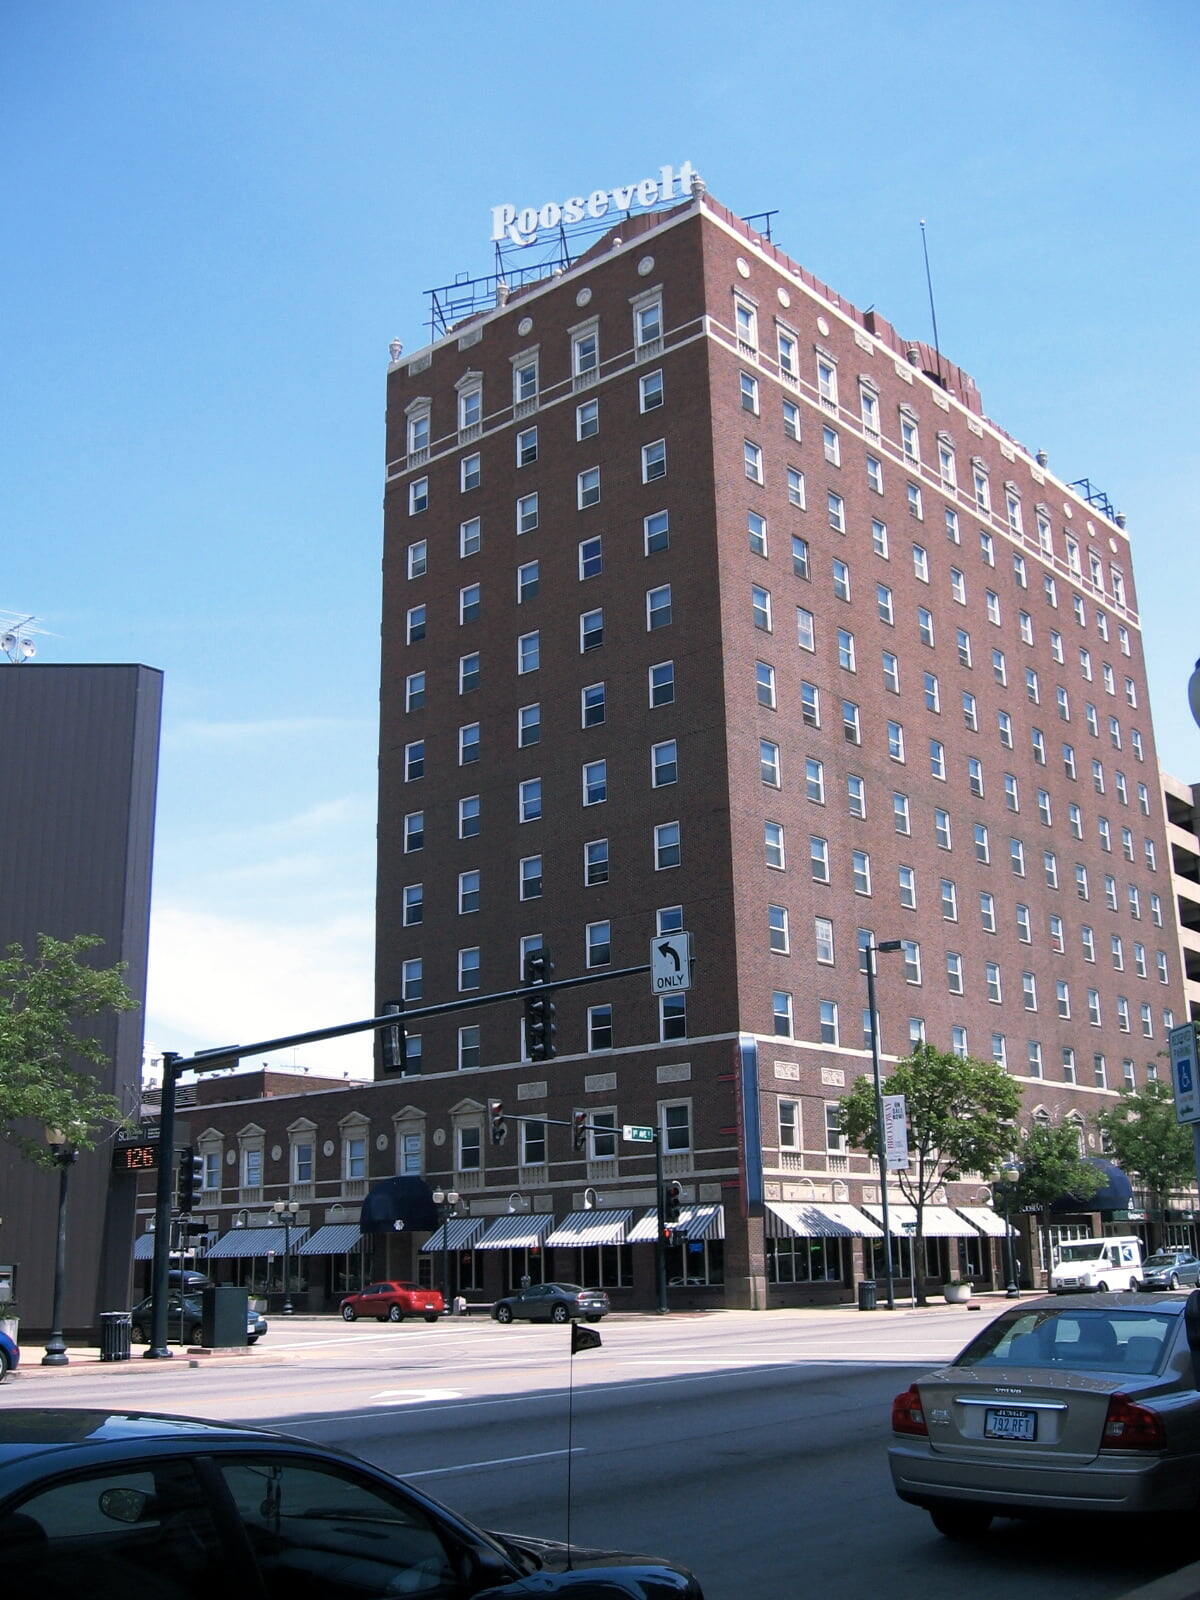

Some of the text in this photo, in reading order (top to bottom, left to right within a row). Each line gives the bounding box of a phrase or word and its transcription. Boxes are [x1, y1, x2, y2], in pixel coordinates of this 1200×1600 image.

[490, 160, 696, 246] Roosevelt
[656, 974, 684, 988] ONLY
[884, 1103, 895, 1149] BROADWAY
[992, 1417, 1031, 1433] 792 RFT
